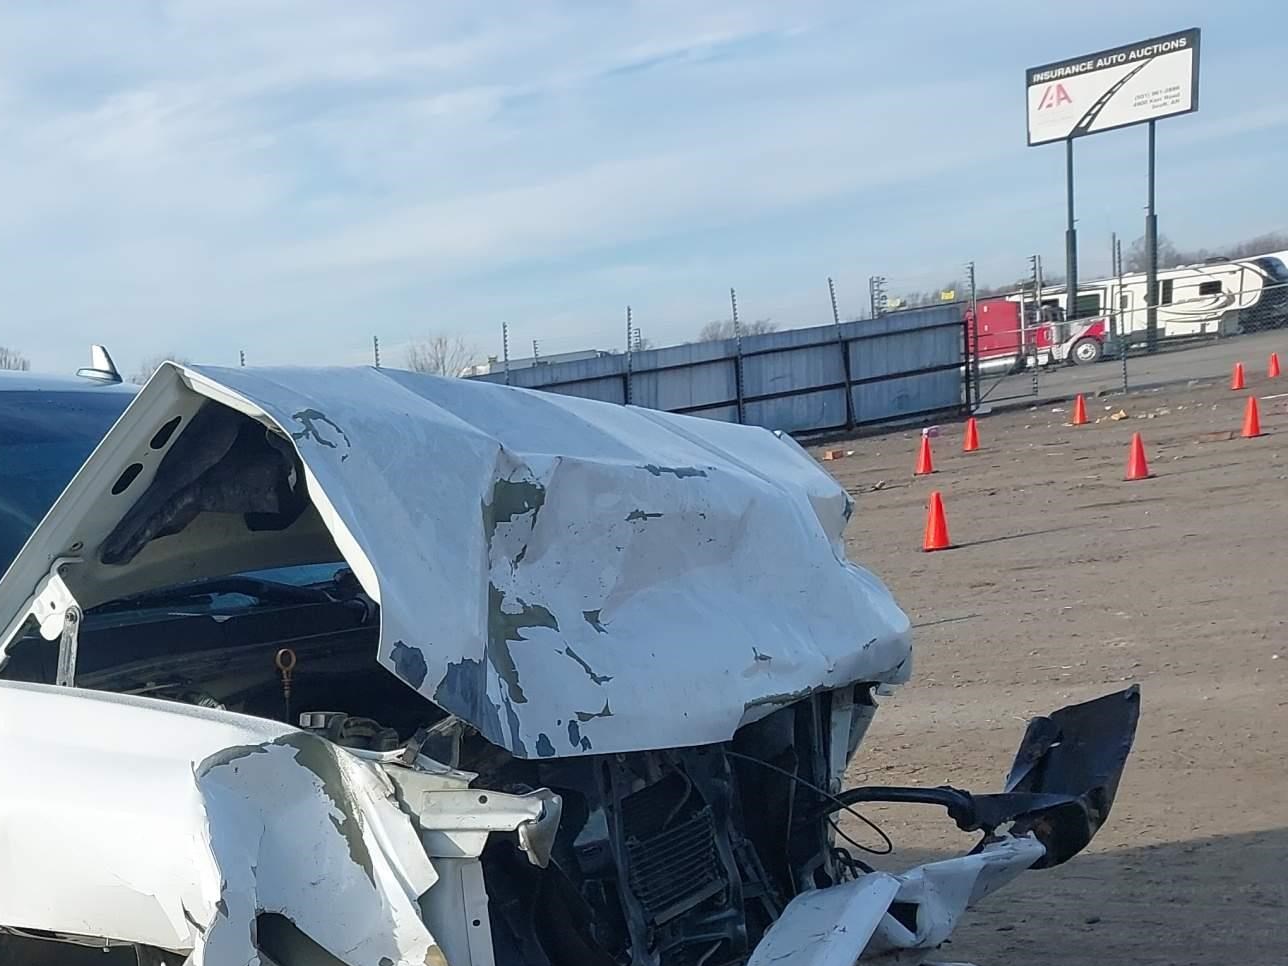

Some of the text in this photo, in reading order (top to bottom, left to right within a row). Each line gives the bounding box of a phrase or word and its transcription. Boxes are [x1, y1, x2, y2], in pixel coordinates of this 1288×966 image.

[1033, 37, 1187, 83] INSURANCE AUTO AUCTIONS
